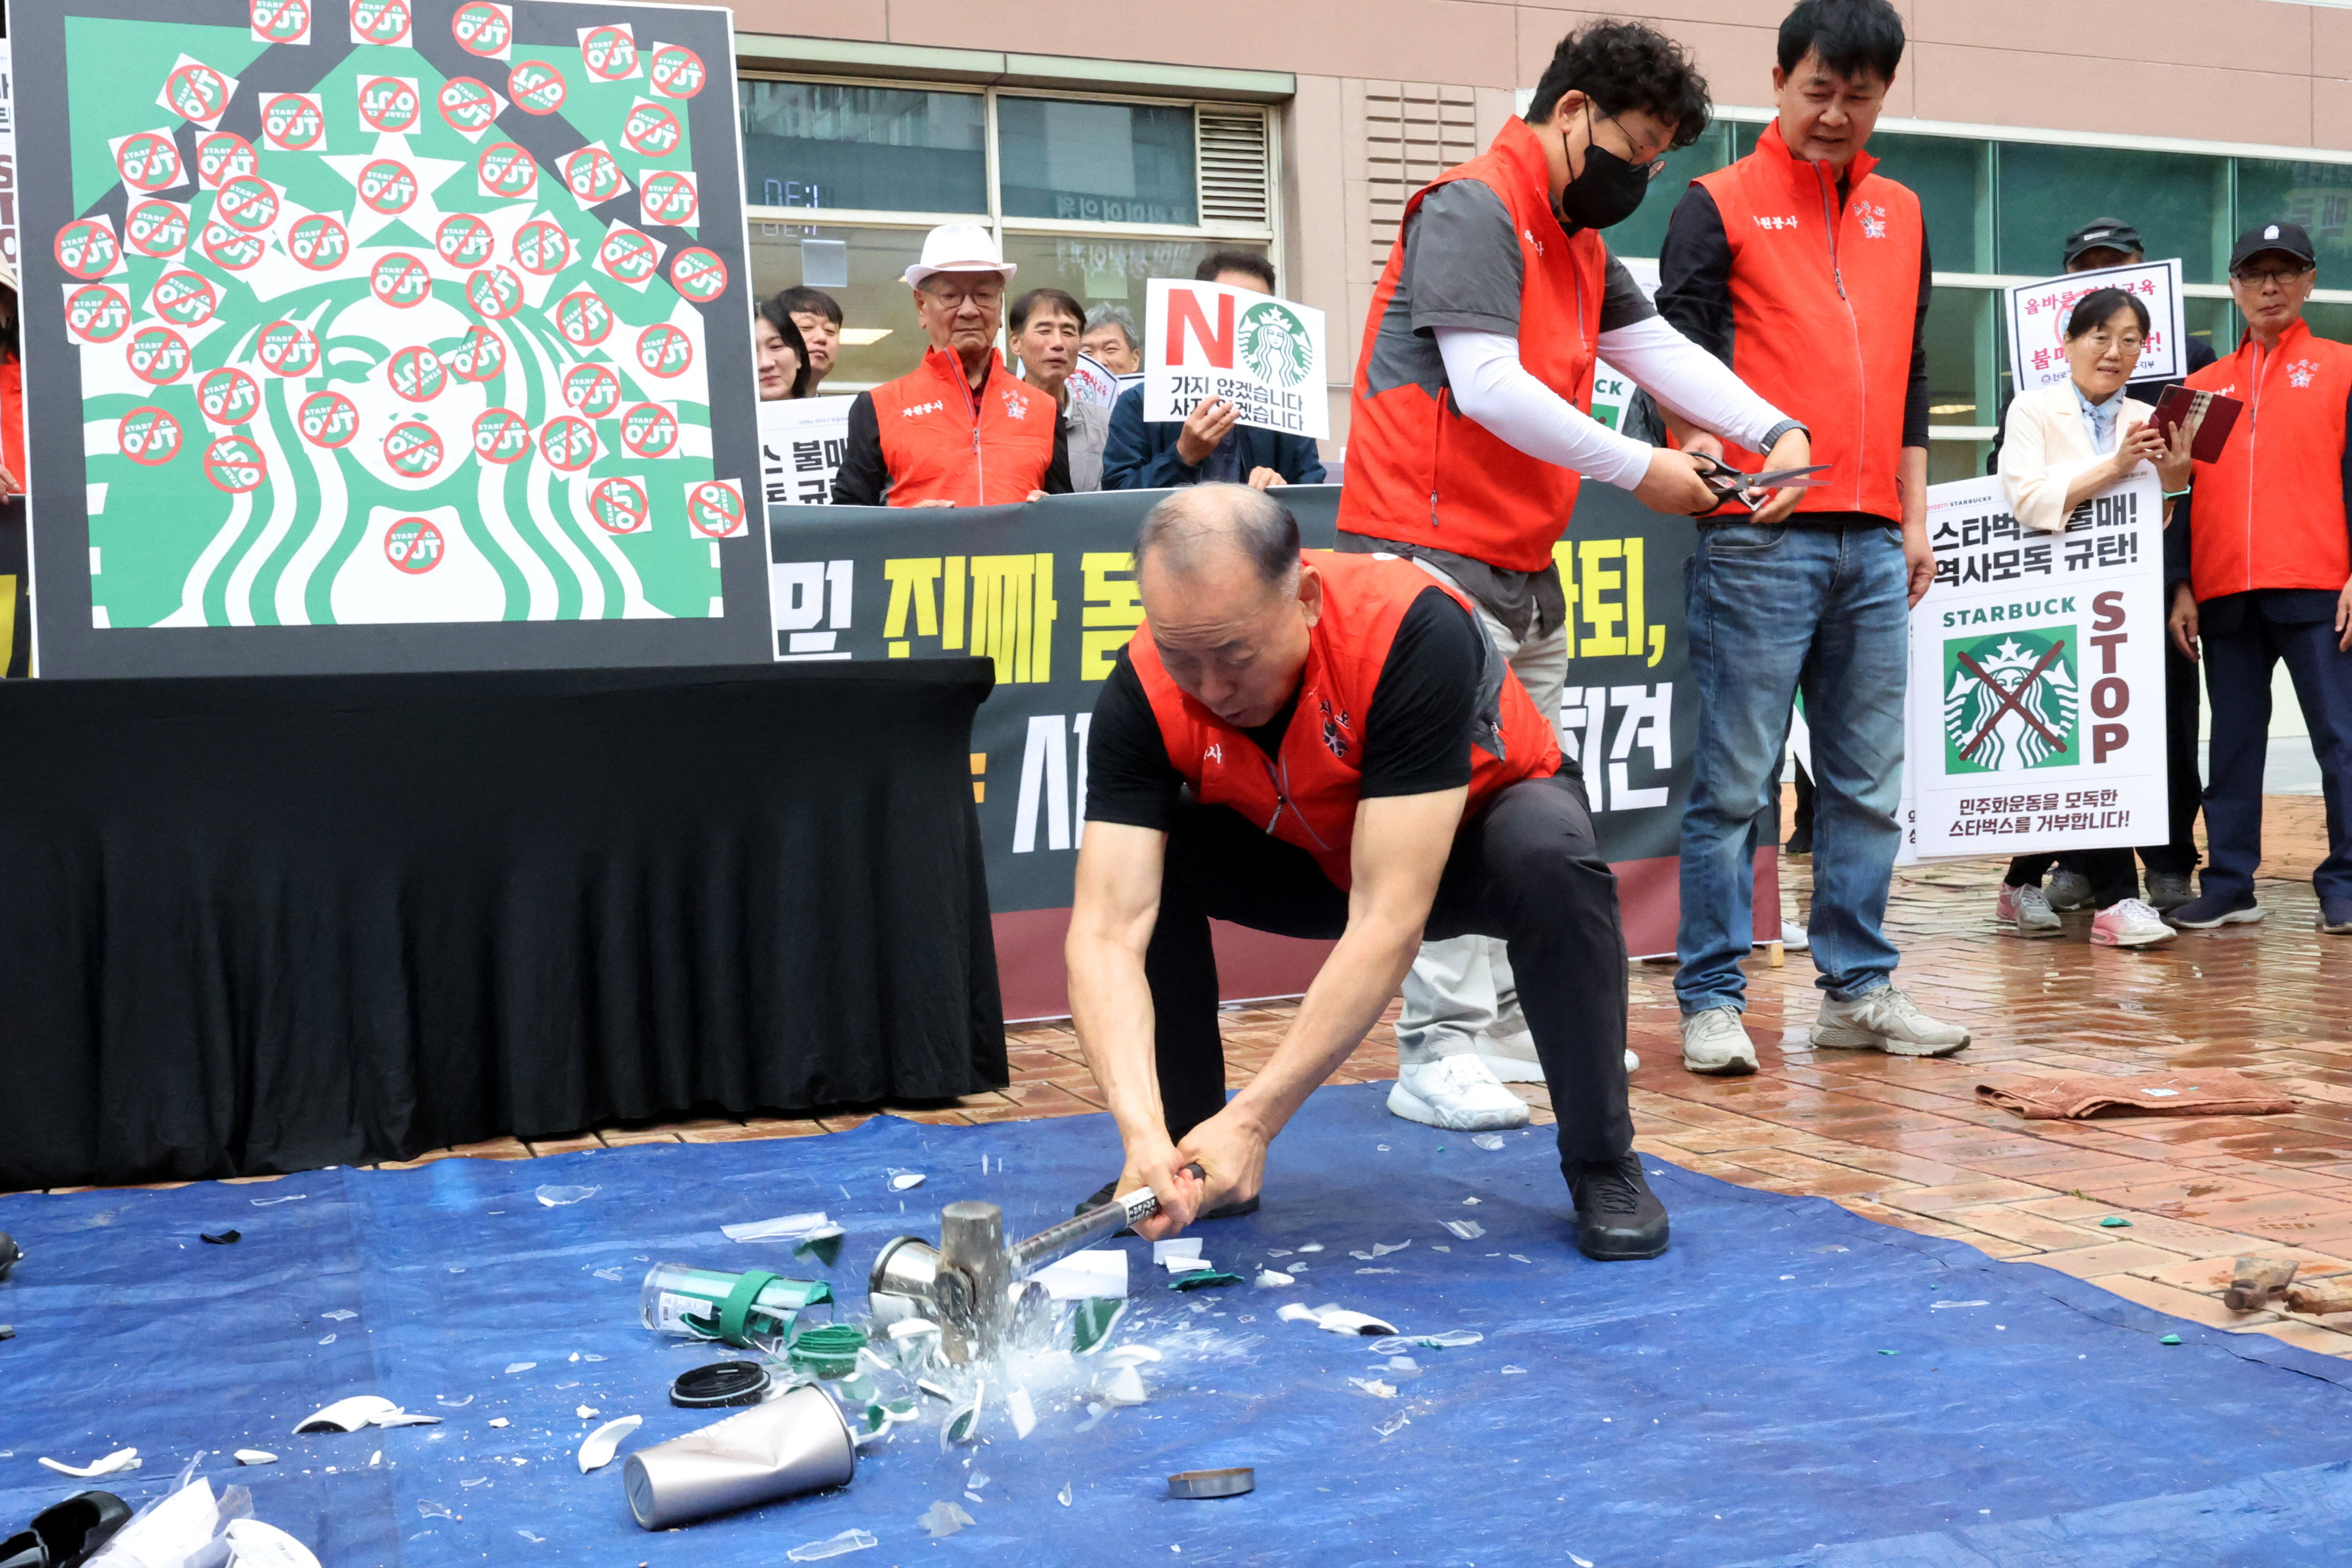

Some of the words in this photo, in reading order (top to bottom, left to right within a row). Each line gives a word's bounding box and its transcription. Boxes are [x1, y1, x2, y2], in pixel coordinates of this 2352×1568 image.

[253, 11, 305, 30] OUT
[356, 13, 406, 32] OUT
[456, 22, 508, 45] OUT
[588, 46, 634, 68] OUT
[512, 67, 563, 100] OUT
[654, 65, 702, 88] OUT
[185, 69, 220, 118] OUT
[363, 90, 414, 110] OUT
[441, 89, 491, 127] OUT
[267, 116, 319, 136] OUT
[628, 120, 677, 149] OUT
[125, 151, 176, 180] OUT
[483, 163, 534, 184] OUT
[574, 162, 617, 194] OUT
[361, 179, 414, 203] OUT
[645, 193, 694, 212] OUT
[220, 192, 276, 225] OUT
[131, 220, 187, 246] OUT
[206, 226, 260, 264] OUT
[294, 234, 345, 260] OUT
[440, 236, 490, 255] OUT
[62, 238, 114, 269] OUT
[522, 232, 566, 269] OUT
[604, 244, 654, 277] OUT
[375, 274, 427, 294] OUT
[482, 269, 518, 316] OUT
[673, 261, 724, 296] OUT
[156, 285, 212, 322] OUT
[2024, 291, 2076, 315] 올바른
[71, 308, 126, 329] OUT
[568, 300, 609, 341] OUT
[132, 349, 186, 371] OUT
[263, 343, 316, 363] OUT
[454, 340, 501, 373] OUT
[642, 341, 688, 368] OUT
[392, 352, 436, 392] OUT
[205, 385, 255, 415] OUT
[568, 385, 617, 405] OUT
[1171, 376, 1209, 394] 가지
[1217, 378, 1303, 412] 않겠습니다
[902, 400, 944, 417] 자원봉사
[304, 411, 355, 437] OUT
[626, 425, 674, 444] OUT
[124, 426, 178, 454] OUT
[476, 429, 526, 451] OUT
[549, 427, 593, 465] OUT
[214, 439, 261, 484] OUT
[387, 437, 440, 472] OUT
[610, 481, 636, 529] OUT
[700, 486, 724, 533] OUT
[1950, 495, 1992, 507] STARBUCKS
[1932, 512, 2052, 552] 스타벅
[389, 539, 441, 561] OUT
[1934, 544, 2053, 587] 역사모독
[2064, 532, 2138, 572] 규탄!
[1552, 537, 1666, 668] 퇴,
[1943, 596, 2077, 627] STARBUCK
[2090, 590, 2130, 764] STOP
[1960, 792, 2060, 816] 민주화운동을
[2065, 789, 2119, 809] 모독한
[1949, 816, 2031, 837] 스타벅스를
[2036, 810, 2130, 833] 거부합니다!
